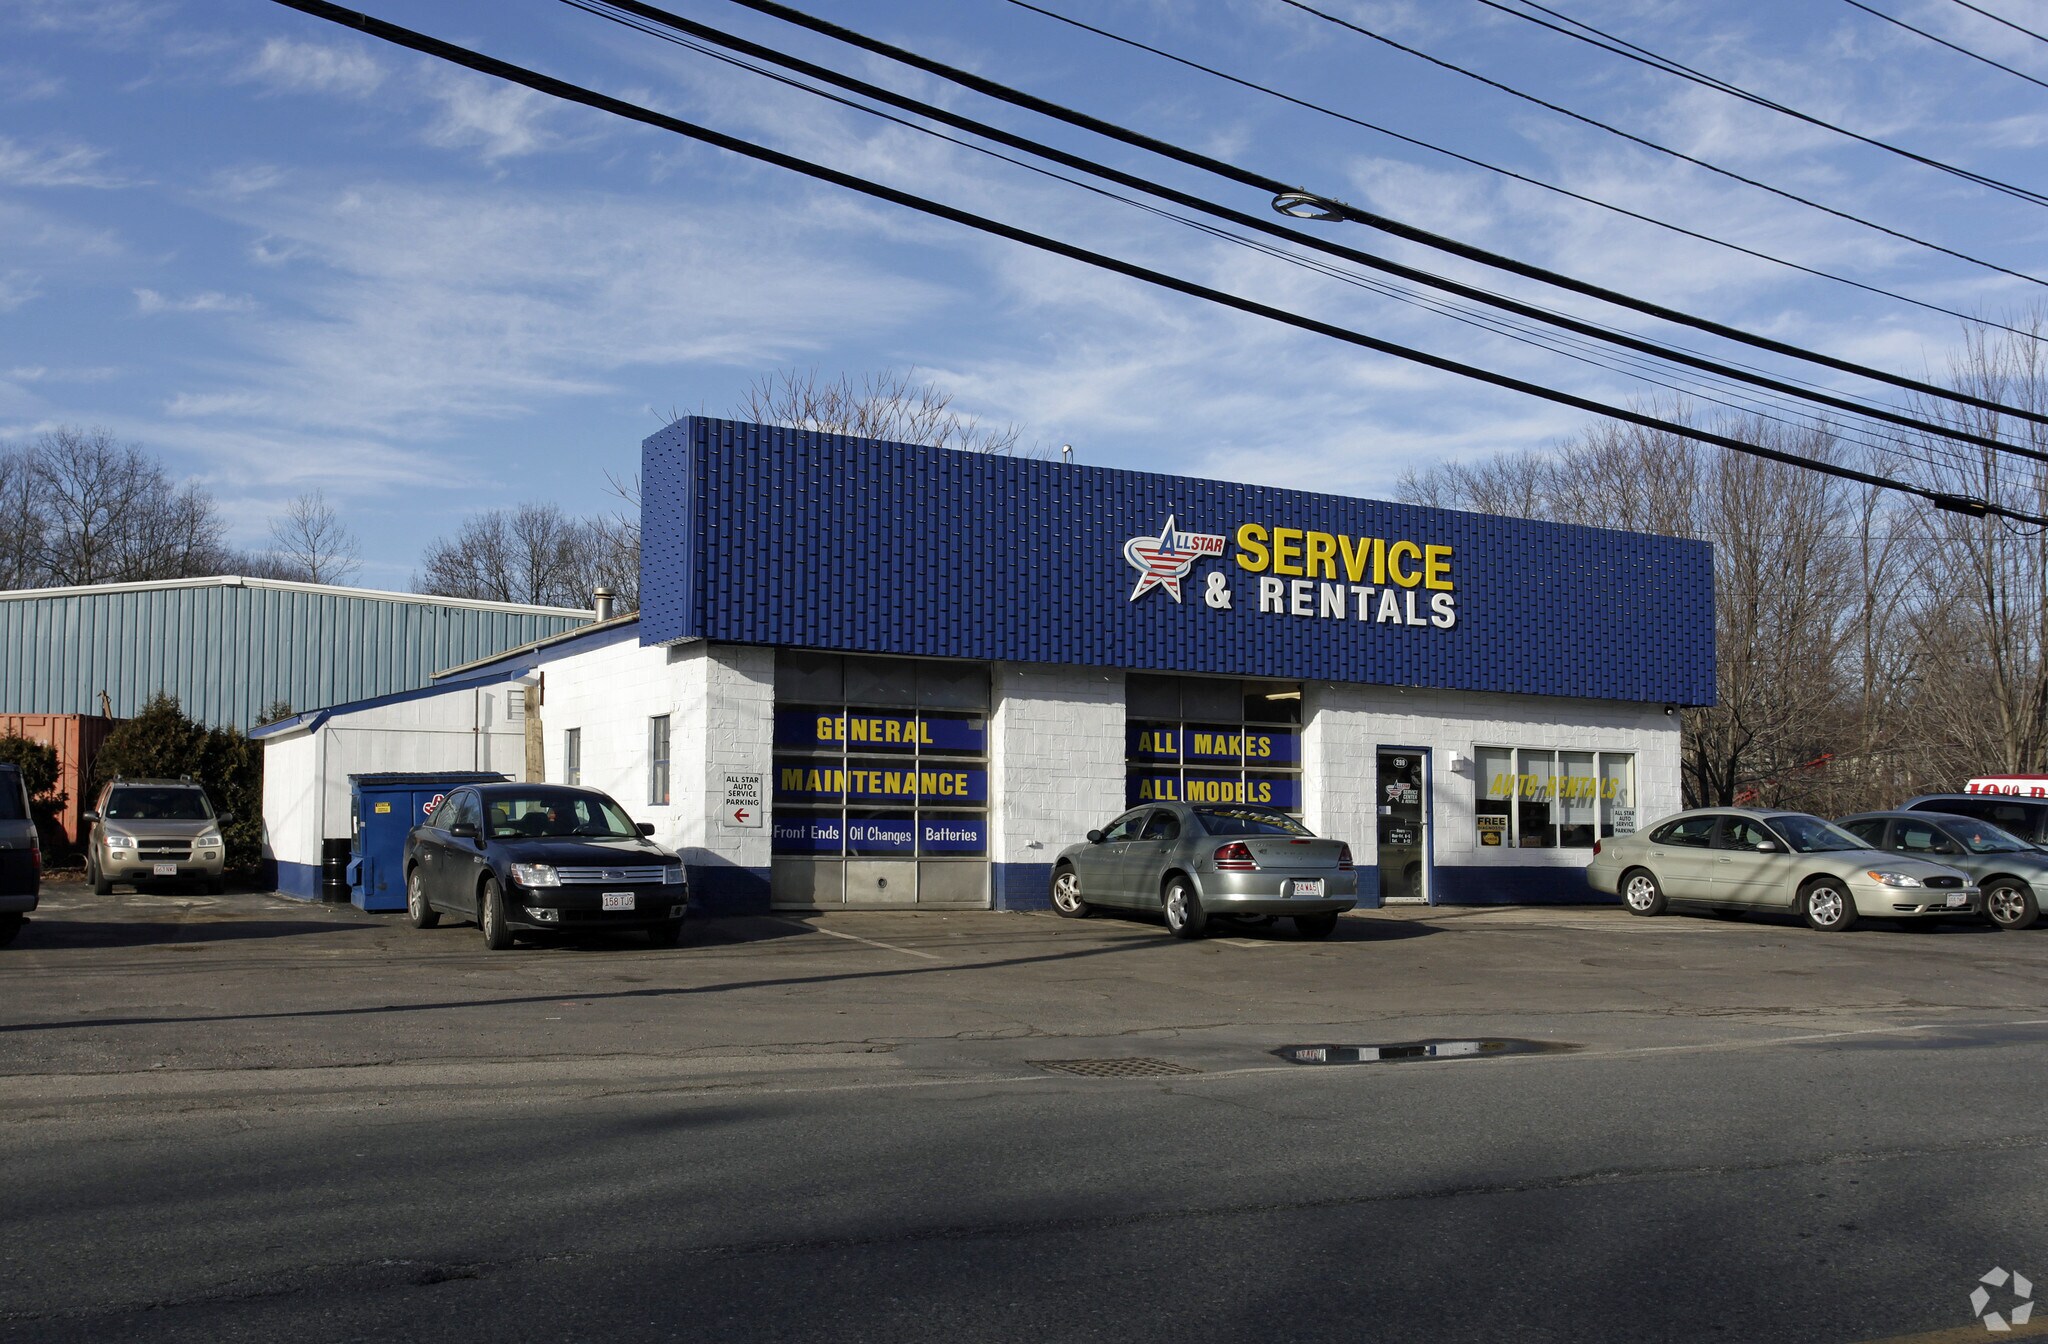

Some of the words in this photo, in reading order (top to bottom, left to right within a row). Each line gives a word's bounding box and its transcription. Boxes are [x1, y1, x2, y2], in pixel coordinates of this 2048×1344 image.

[1236, 524, 1453, 590] SERVICE
[1205, 572, 1231, 609] &
[1260, 576, 1455, 628] RENTALS
[817, 717, 933, 743] GENERAL
[1138, 732, 1177, 753] ALL
[1194, 734, 1271, 757] MAKES
[782, 768, 968, 795] MAINTENANCE
[1139, 779, 1178, 800] ALL
[1187, 781, 1271, 803] MODELS
[1490, 774, 1539, 797] AUTO
[1544, 776, 1619, 799] RENTALS
[774, 825, 805, 839] Front
[811, 826, 839, 839] Ends
[1477, 817, 1506, 825] FREE
[850, 826, 864, 840] Oil
[867, 827, 912, 845] Changes
[925, 827, 977, 842] Batteries
[604, 897, 618, 906] 158
[621, 896, 633, 906] TJ9
